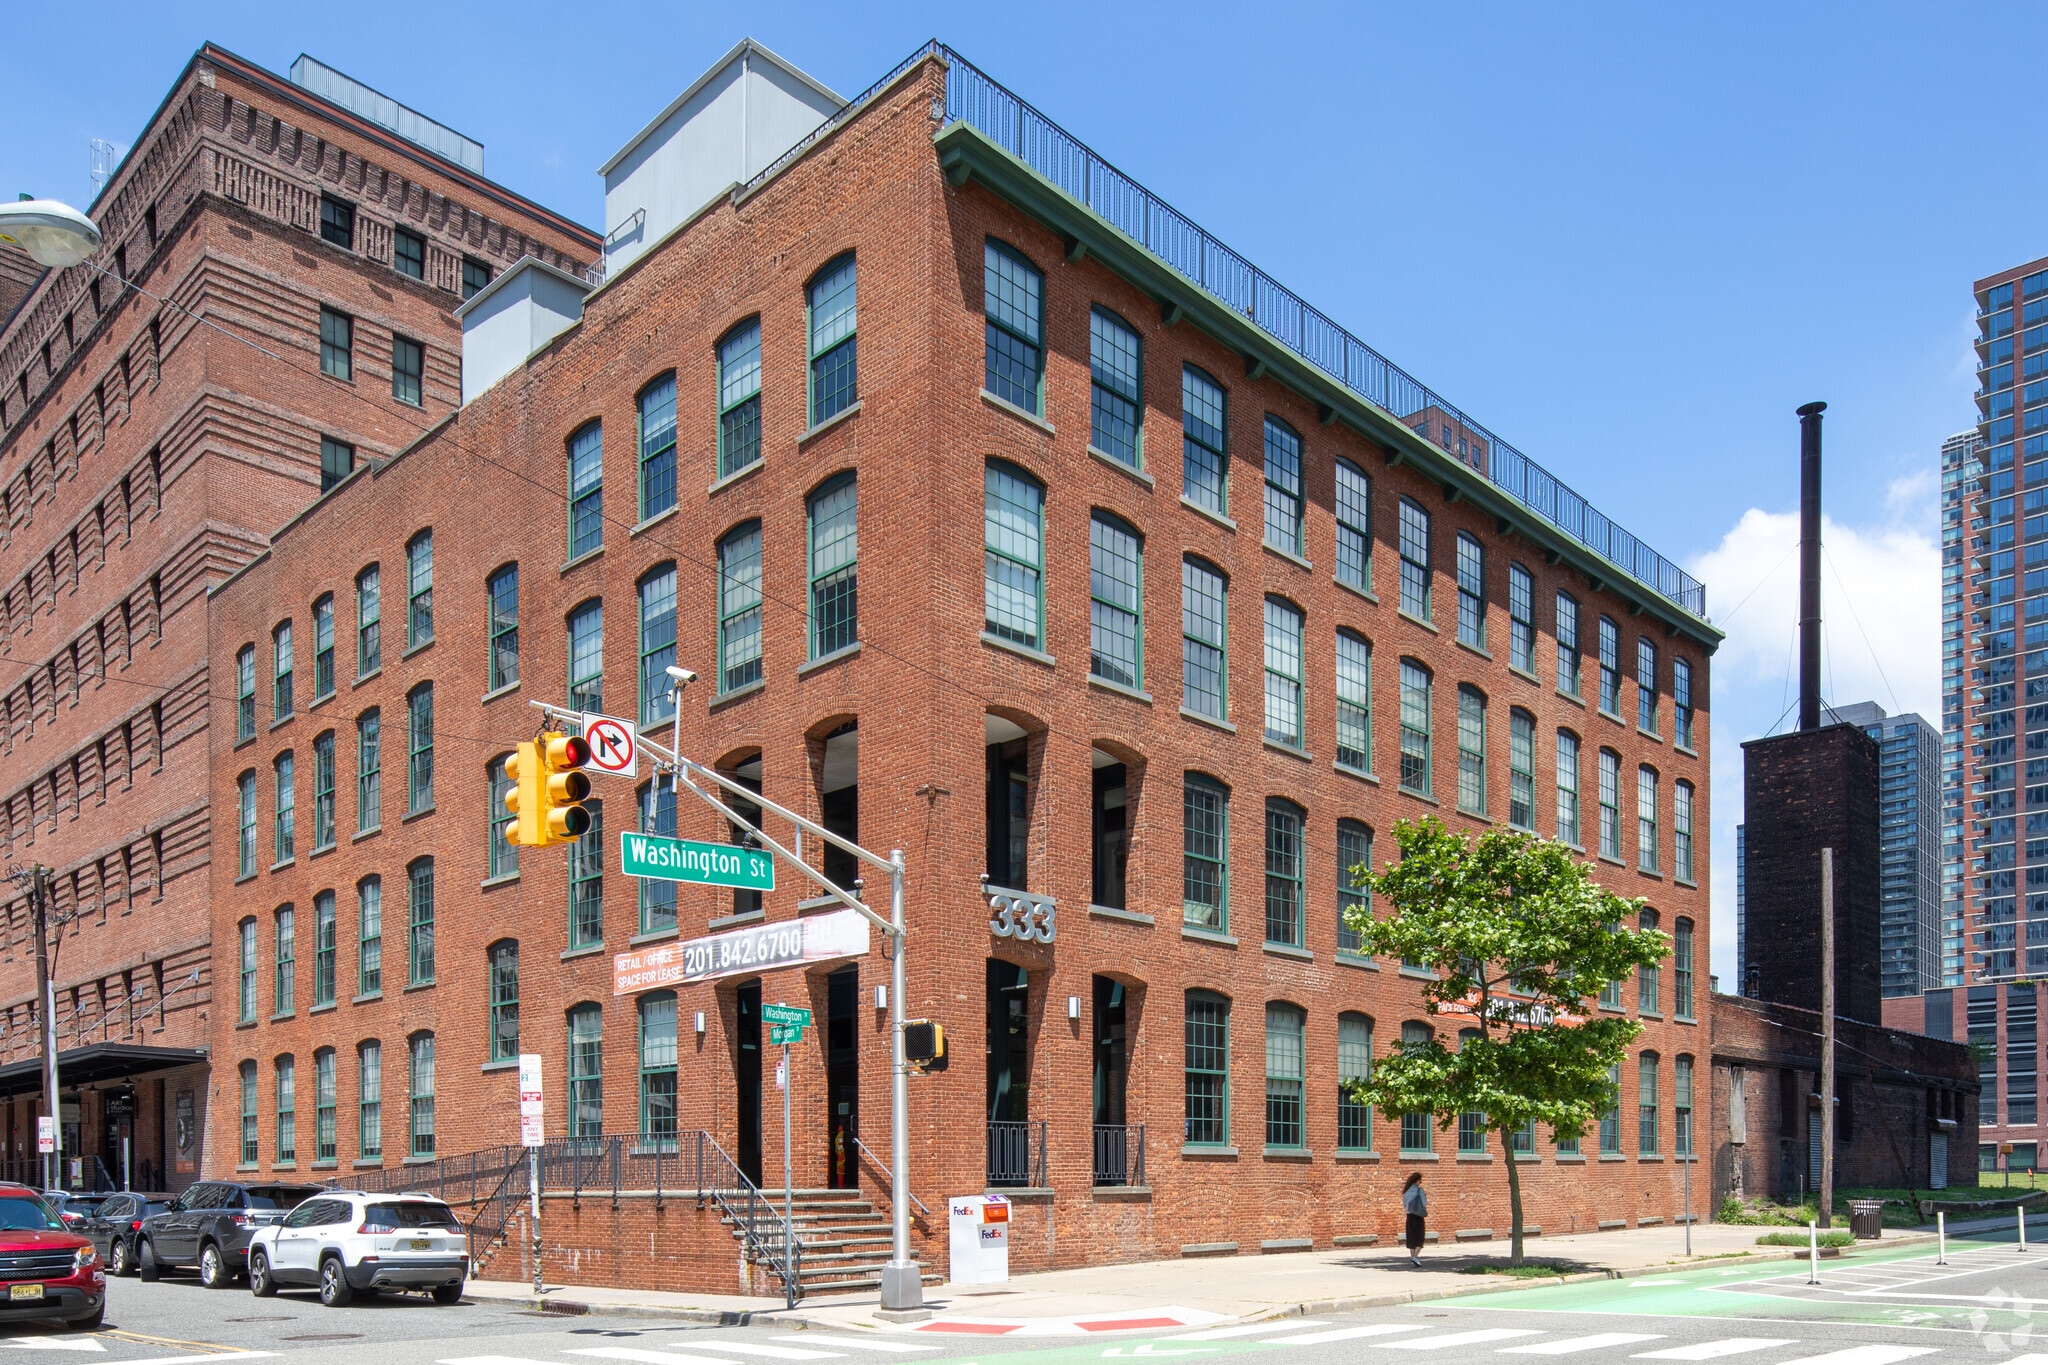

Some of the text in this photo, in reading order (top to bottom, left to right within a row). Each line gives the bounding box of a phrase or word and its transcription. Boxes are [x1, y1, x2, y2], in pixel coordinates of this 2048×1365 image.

[630, 837, 766, 879] Washington St
[989, 895, 1057, 944] 333
[617, 957, 642, 972] RETAIL
[647, 949, 673, 966] OFFICE
[685, 929, 801, 974] 201.842.6700
[617, 966, 681, 988] SPACE FOR LEASE
[765, 1006, 802, 1025] Washington
[954, 1206, 974, 1215] FedEx
[981, 1229, 1002, 1239] FedEx
